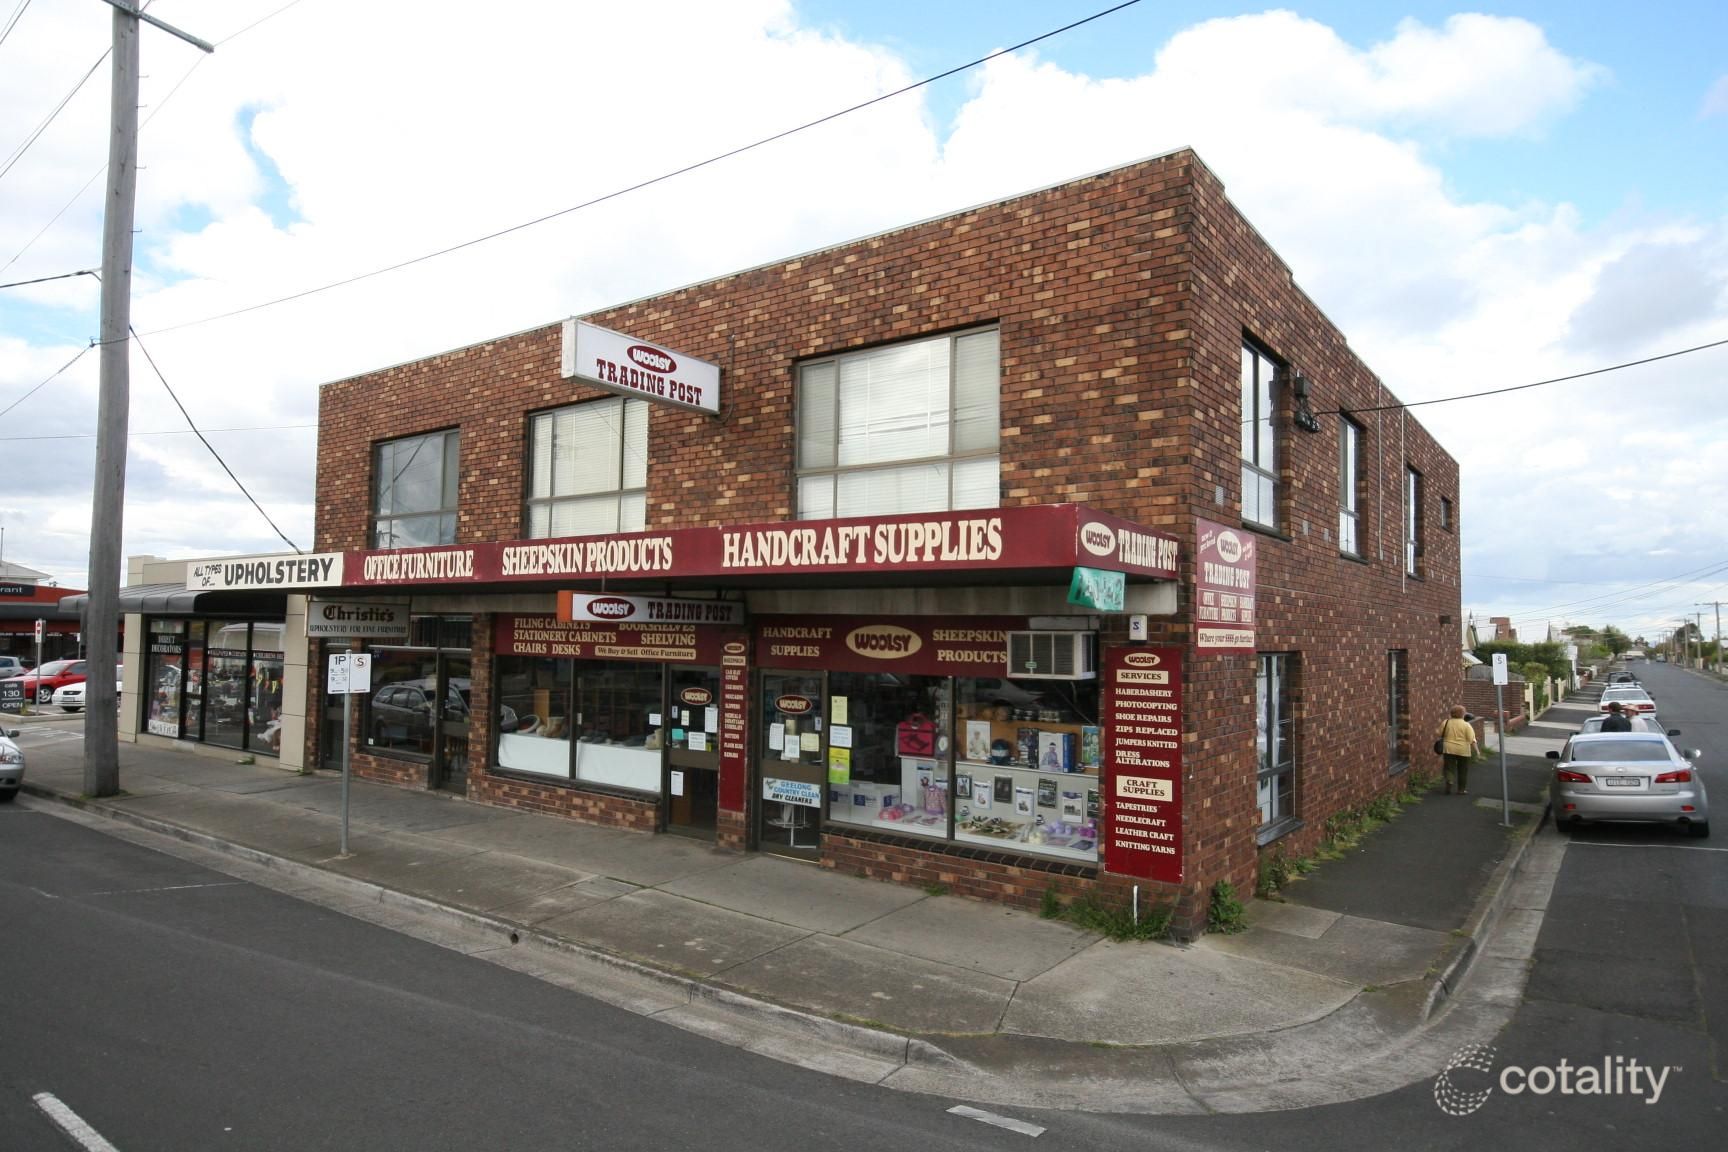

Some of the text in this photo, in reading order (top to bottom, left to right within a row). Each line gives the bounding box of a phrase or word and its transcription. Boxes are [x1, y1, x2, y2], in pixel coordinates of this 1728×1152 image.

[633, 348, 671, 371] WOOLSY
[596, 358, 702, 405] TRADING POST
[722, 518, 1002, 567] HANDCRAFT SUPPLIES
[1086, 530, 1110, 548] WOOLSY
[1118, 528, 1156, 568] TRADING
[1158, 538, 1178, 571] POST
[1220, 538, 1239, 556] WOOLSY
[502, 537, 672, 576] SHEEPSKIN PRODUCTS
[194, 564, 222, 576] ALL TYPES
[364, 550, 474, 580] OFFICE FURNITURE
[224, 558, 334, 586] UPHOLSTERY
[1204, 562, 1250, 589] TRADING POST
[323, 604, 394, 622] Christie's
[592, 602, 630, 616] WOOLSY
[648, 602, 732, 622] TRADING POST
[310, 624, 346, 632] UPHOLSTERY
[514, 618, 591, 630] FILING CABINETS
[514, 630, 616, 644] STATIONERY CABINETS
[764, 627, 832, 639] HANDCRAFT
[932, 630, 1008, 642] SHEEPSKIN
[641, 633, 696, 646] SHELVING
[854, 633, 912, 652] WOOLSY
[514, 642, 580, 656] CHAIRS DESKS
[608, 647, 618, 655] Buy
[661, 650, 694, 658] Furniture
[771, 645, 820, 657] SUPPLIES
[334, 656, 346, 665] 1P
[937, 650, 1007, 663] PRODUCTS
[1121, 672, 1162, 680] SERVICES
[1116, 688, 1172, 697] HABERDASHERY
[1116, 701, 1177, 710] PHOTOCOPYING
[1137, 714, 1172, 723] REPAIRS
[1136, 726, 1178, 736] REPLACED
[1116, 738, 1178, 748] JUMPERS KNITTED
[1116, 750, 1140, 758] DRESS
[1116, 757, 1170, 768] ALTERATIONS
[781, 781, 812, 790] GEELONG
[1127, 779, 1158, 788] CRAFT
[774, 787, 800, 795] COUNTRY
[1123, 786, 1165, 796] SUPPLIES
[785, 795, 812, 804] CLEANERS
[1116, 802, 1157, 812] TAPESTRIES
[1116, 815, 1166, 827] NEEDLECRAFT
[1116, 827, 1174, 841] LEATHER CRAFT
[1116, 840, 1176, 855] KNITTING YARNS
